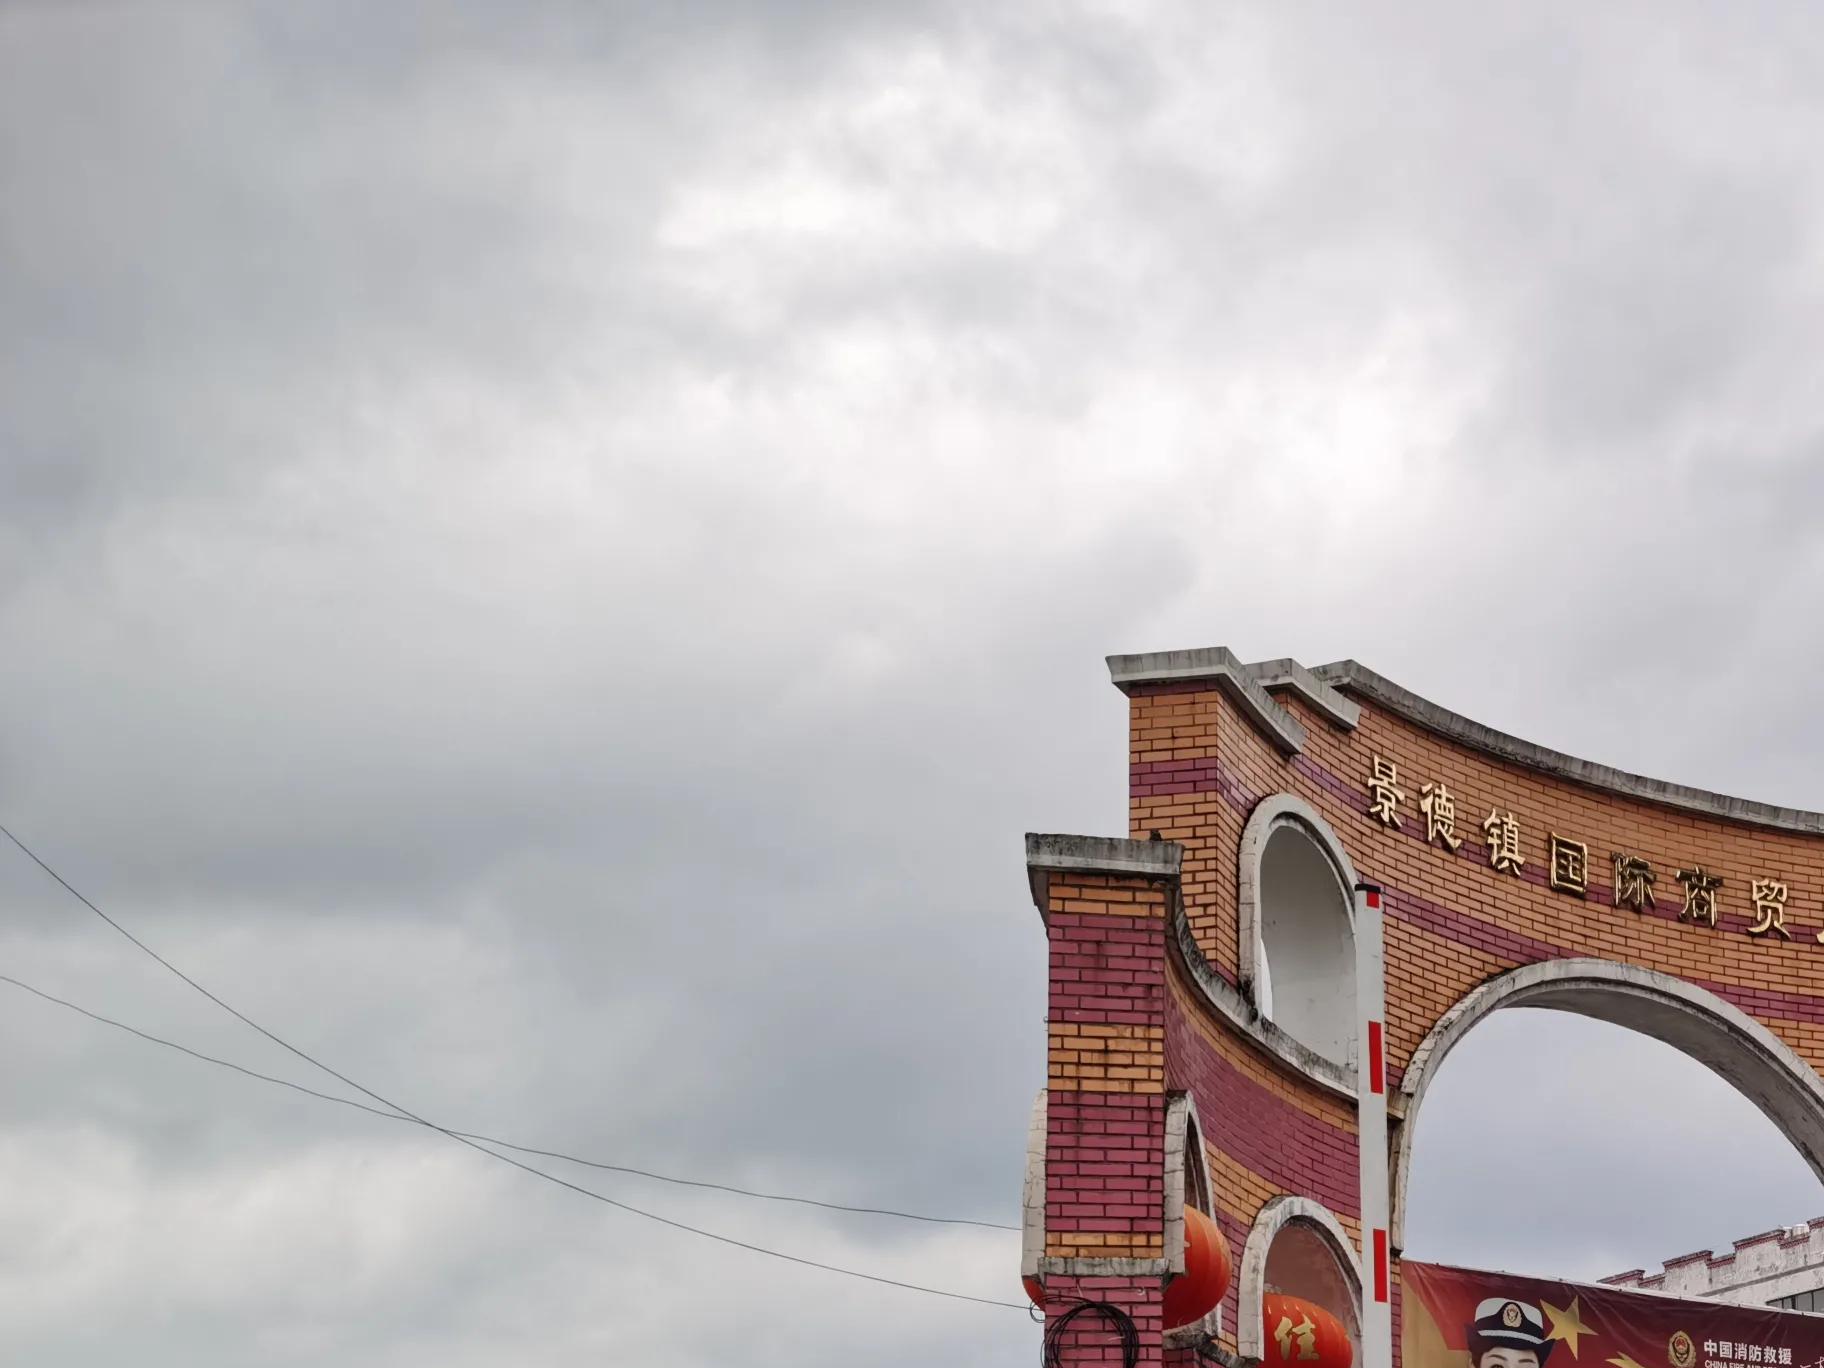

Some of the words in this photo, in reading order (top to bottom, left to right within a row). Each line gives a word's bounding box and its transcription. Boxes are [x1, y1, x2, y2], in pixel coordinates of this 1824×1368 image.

[1274, 1314, 1320, 1360] 佳
[1703, 1339, 1793, 1365] 中国消防救援
